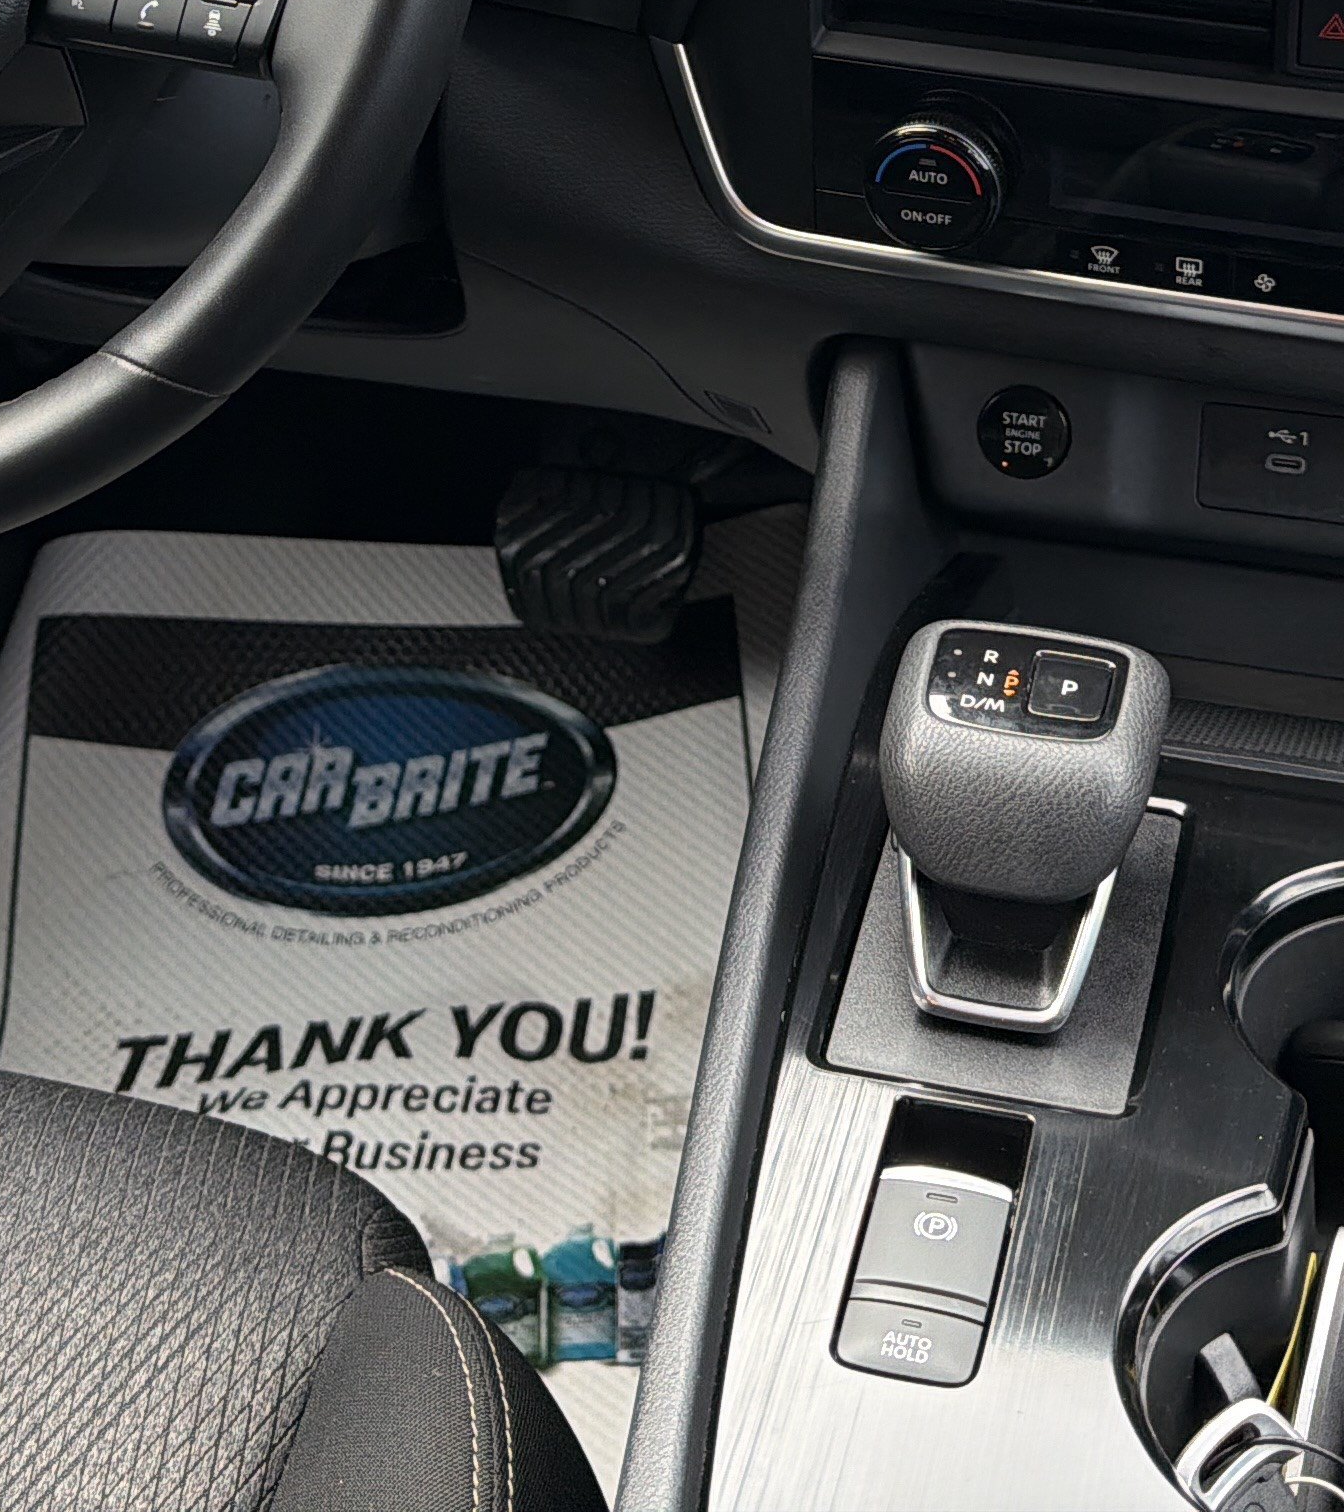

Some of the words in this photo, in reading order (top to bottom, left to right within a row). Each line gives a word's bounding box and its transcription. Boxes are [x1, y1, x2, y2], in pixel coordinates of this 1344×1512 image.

[908, 168, 949, 186] AUTO
[1087, 261, 1122, 275] FRONT
[1175, 275, 1204, 288] REAR
[1002, 411, 1047, 429] START
[1004, 427, 1041, 441] ENGINE
[1003, 439, 1043, 457] STOP
[983, 649, 1000, 664] R
[976, 671, 995, 687] N
[1060, 679, 1079, 696] P
[959, 694, 1005, 713] D/M
[313, 863, 396, 883] SINCE
[402, 851, 469, 881] 1947
[152, 860, 266, 943] PROFESSIONAL
[270, 924, 366, 947] DETAILING
[386, 889, 543, 945] RECONDITIONING
[542, 818, 629, 895] PRODUCTS
[116, 1007, 429, 1094] THANK
[450, 989, 657, 1065] YOU!
[198, 1086, 268, 1115] We
[276, 1075, 553, 1119] Appreciate
[321, 1129, 543, 1173] Business
[882, 1330, 933, 1352] AUTO
[879, 1342, 930, 1365] HOLD
